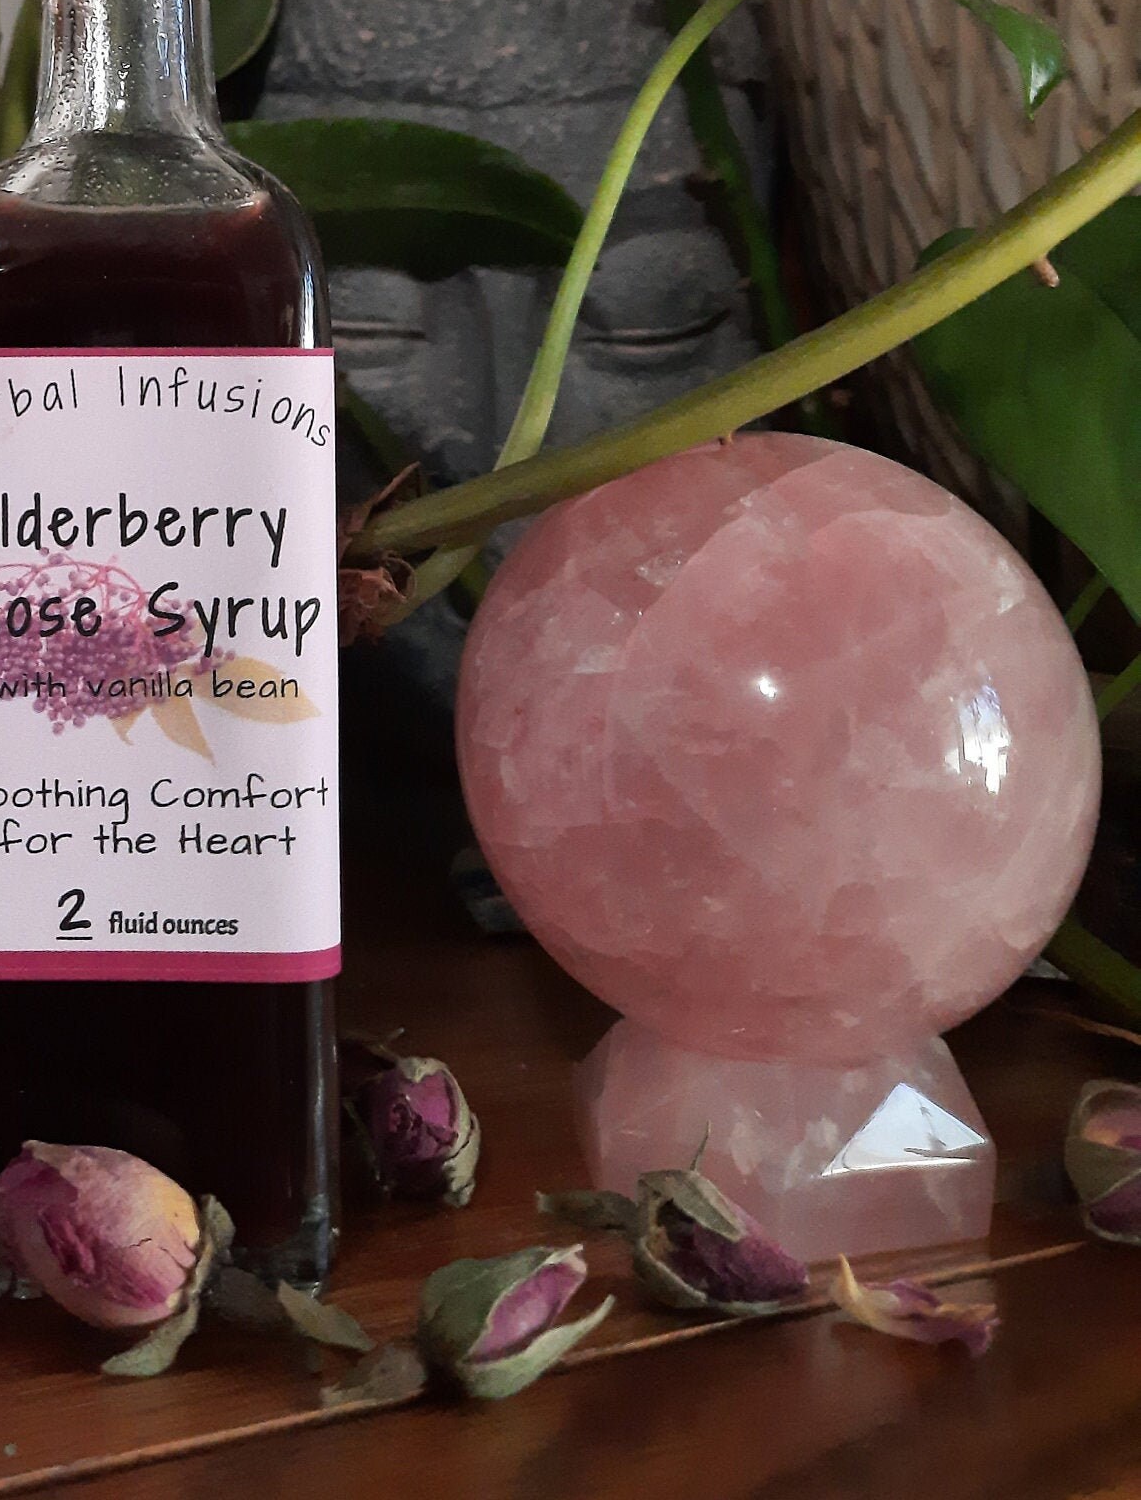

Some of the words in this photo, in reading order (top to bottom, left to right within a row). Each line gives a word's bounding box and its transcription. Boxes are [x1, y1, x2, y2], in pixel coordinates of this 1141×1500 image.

[118, 365, 331, 447] Infusions
[148, 581, 321, 657] Syrup
[87, 670, 194, 698] vanilla
[213, 669, 299, 699] bean
[151, 773, 329, 809] Comfort
[93, 823, 157, 854] the
[178, 824, 297, 856] Heart
[57, 888, 92, 931] 2
[108, 911, 158, 935] fluid
[163, 915, 239, 935] ounces
